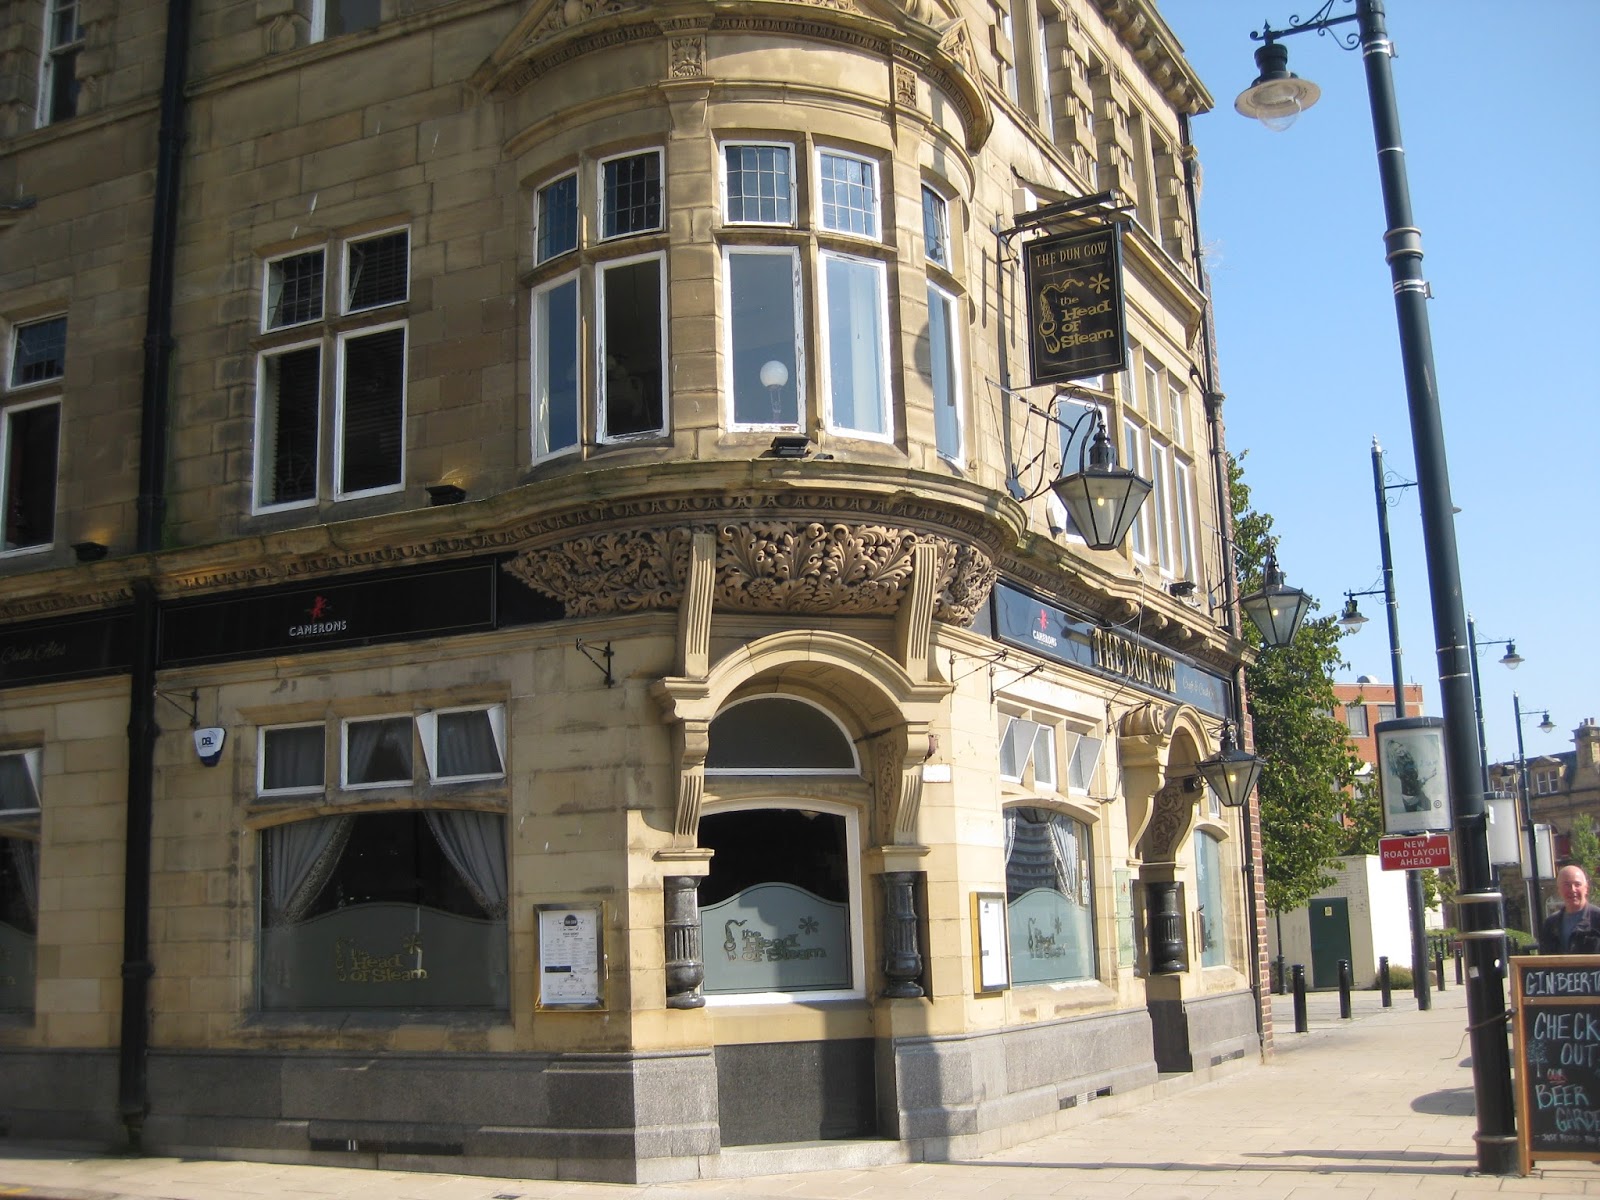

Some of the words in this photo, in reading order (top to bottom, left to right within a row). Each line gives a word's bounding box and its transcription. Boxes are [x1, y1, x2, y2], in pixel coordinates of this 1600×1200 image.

[1036, 252, 1056, 267] THE
[1060, 246, 1081, 262] DUN
[1084, 241, 1108, 258] COW
[1060, 296, 1079, 306] the
[1061, 300, 1112, 321] Head
[1060, 329, 1114, 348] Steam
[289, 620, 347, 636] CAMERONS
[1093, 627, 1123, 674] THE
[1124, 639, 1151, 684] DUN
[1152, 652, 1177, 693] COW
[1383, 850, 1409, 859] ROAD
[1412, 847, 1447, 857] LAYOUT
[1403, 840, 1425, 849] NEW
[1400, 857, 1432, 866] AHEAD
[1534, 1012, 1600, 1040] CHECK
[1560, 1042, 1599, 1068] OUT
[1535, 1084, 1589, 1110] BEER
